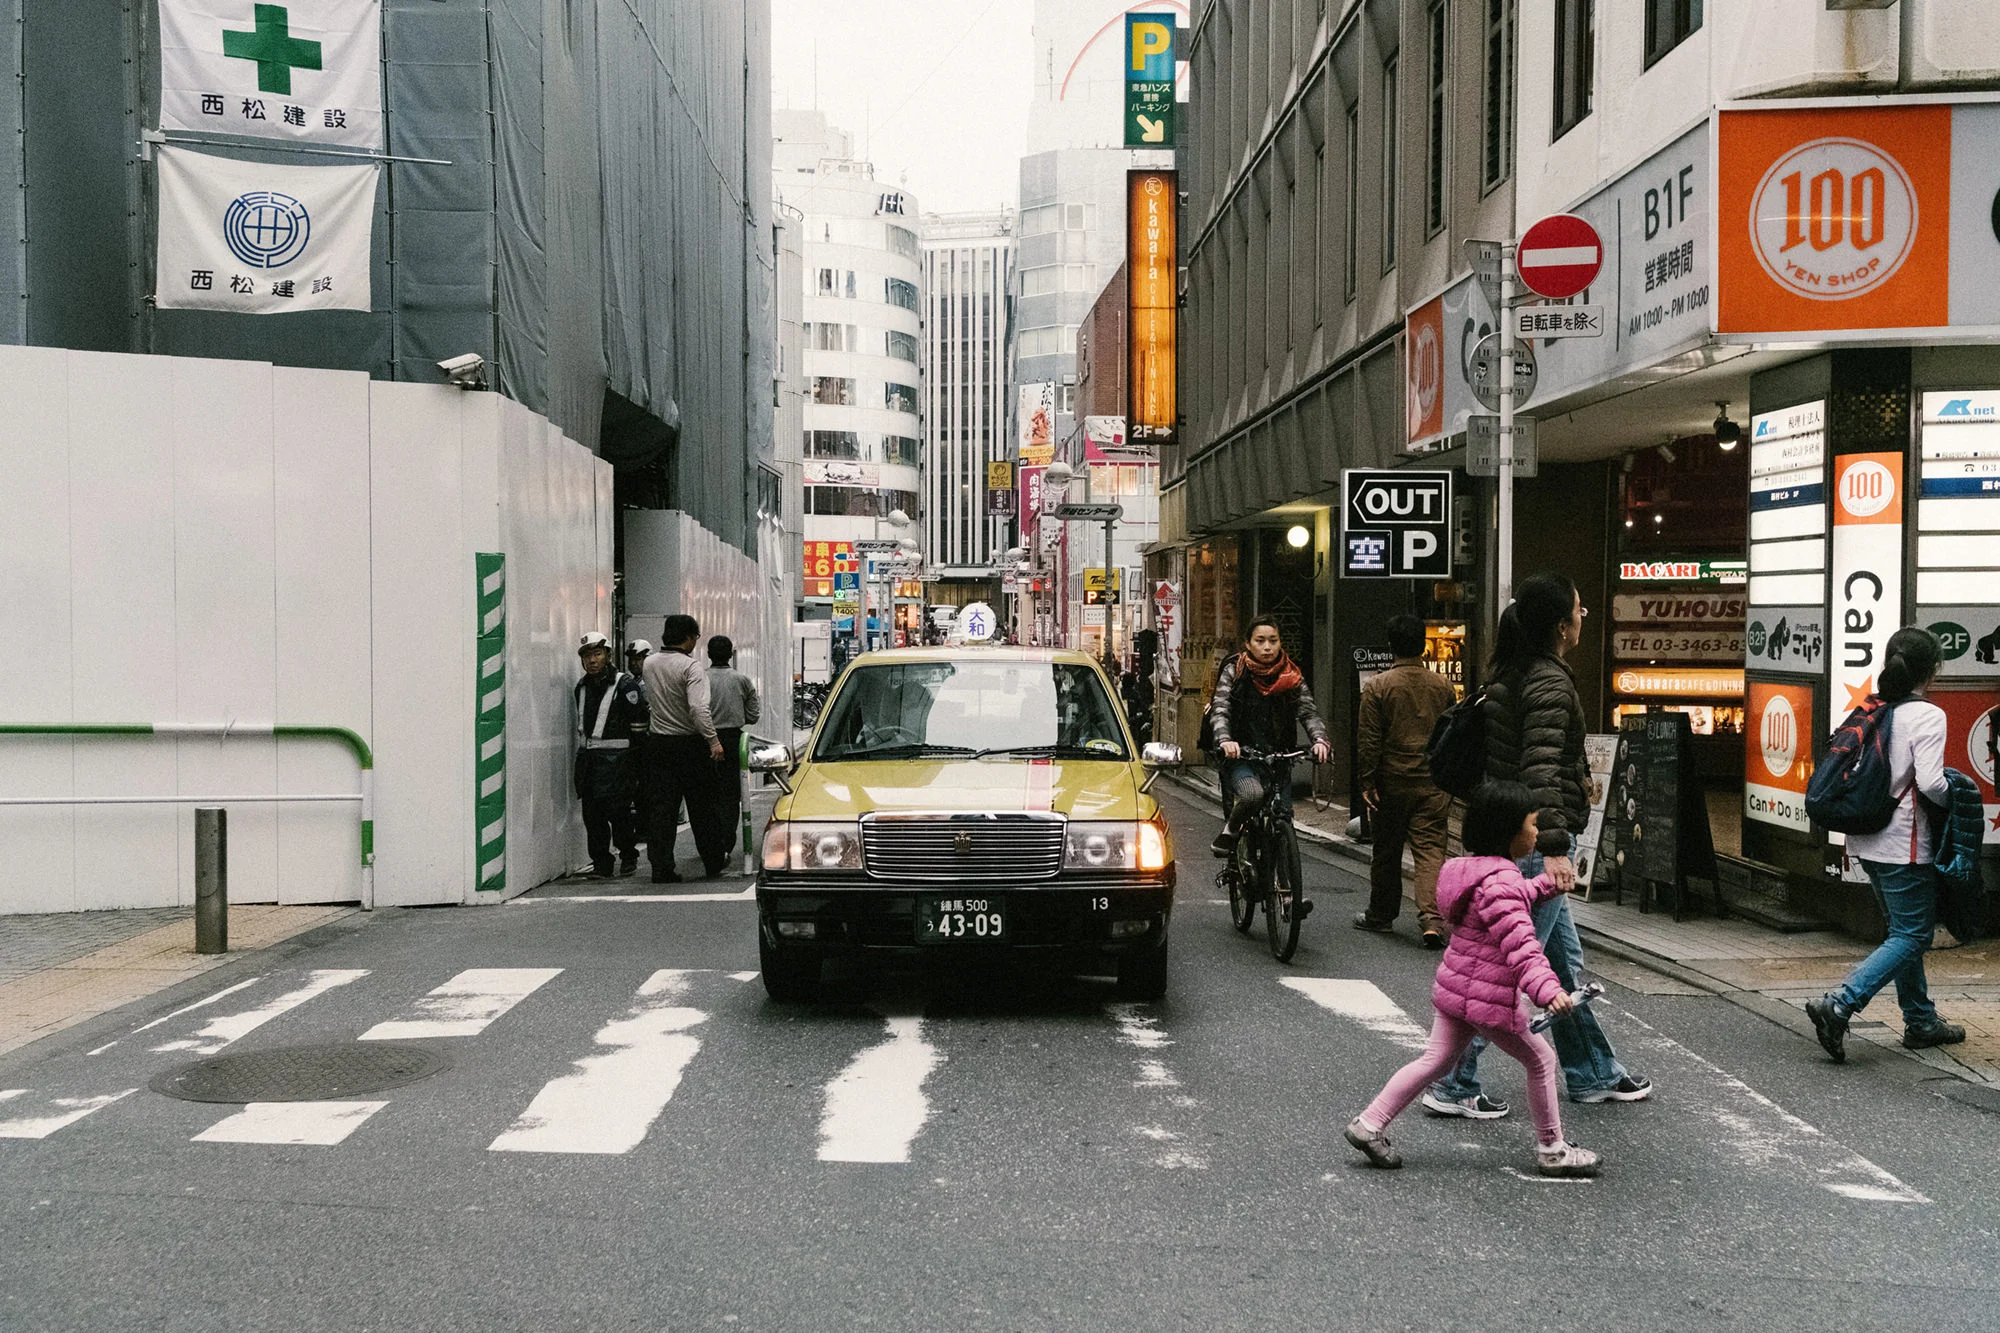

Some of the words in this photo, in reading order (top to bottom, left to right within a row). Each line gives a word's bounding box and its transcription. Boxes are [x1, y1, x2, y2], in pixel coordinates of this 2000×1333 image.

[1132, 22, 1170, 70] P
[1132, 83, 1171, 92] 東急ハンズ
[201, 94, 347, 129] 西松建設
[1131, 102, 1170, 112] パーキング
[1645, 164, 1694, 242] B1F
[1780, 166, 1885, 253] 100
[1147, 198, 1160, 280] kawara
[1644, 239, 1694, 294] 営業時間
[1785, 259, 1822, 286] YEN
[1828, 257, 1880, 287] SHOP
[191, 270, 333, 298] 西松建設
[1520, 312, 1598, 332] 自転車を除く
[1629, 315, 1642, 337] AM
[1643, 305, 1663, 329] 10:00
[1671, 294, 1685, 319] PM
[1686, 284, 1710, 311] 10:00
[1974, 407, 1995, 415] net
[1132, 425, 1153, 438] 2F
[1847, 471, 1882, 500] 100
[1365, 487, 1439, 515] OUT
[1349, 537, 1385, 569] 空
[1403, 530, 1438, 570] P
[841, 573, 854, 589] P
[1620, 563, 1700, 579] BACARI
[1087, 591, 1098, 604] P
[969, 608, 985, 636] 大和
[1844, 570, 1883, 668] Can
[1621, 638, 1649, 651] TEL
[1748, 631, 1766, 646] B2F
[1939, 632, 1967, 650] 2F
[1640, 676, 1680, 691] kawara
[1766, 711, 1790, 753] 100
[1749, 794, 1768, 814] Can
[1777, 801, 1792, 818] Do
[940, 899, 964, 912] 練馬
[966, 899, 988, 912] 500
[1092, 897, 1109, 911] 13
[927, 920, 935, 932] う
[938, 913, 1002, 937] 43-09
